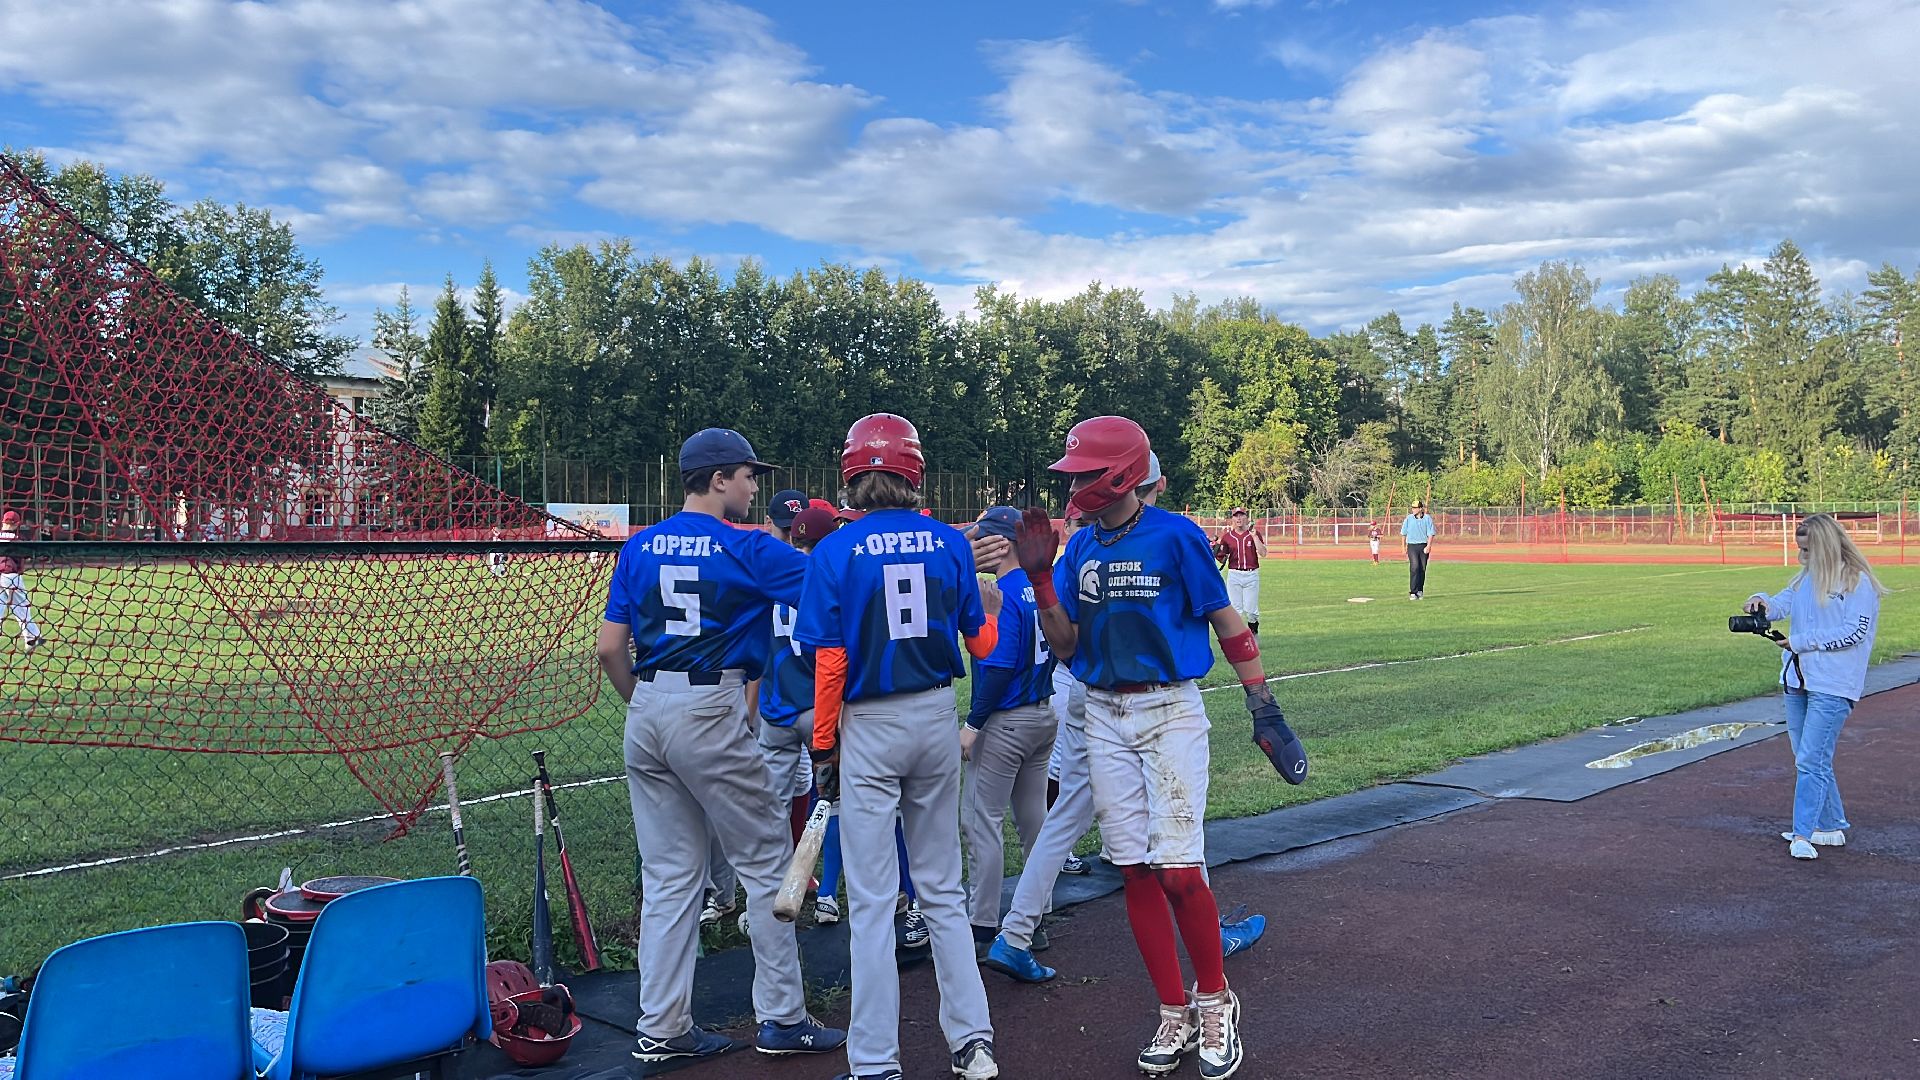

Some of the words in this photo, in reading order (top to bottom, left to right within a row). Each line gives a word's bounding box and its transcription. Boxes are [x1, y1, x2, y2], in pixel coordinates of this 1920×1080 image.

[652, 534, 712, 557] ОРЕЛ
[865, 531, 935, 555] ОРЕЛ
[1108, 561, 1142, 573] КУБОК
[659, 564, 701, 637] 5
[882, 562, 928, 641] 8
[1823, 614, 1870, 651] HOLLISTER
